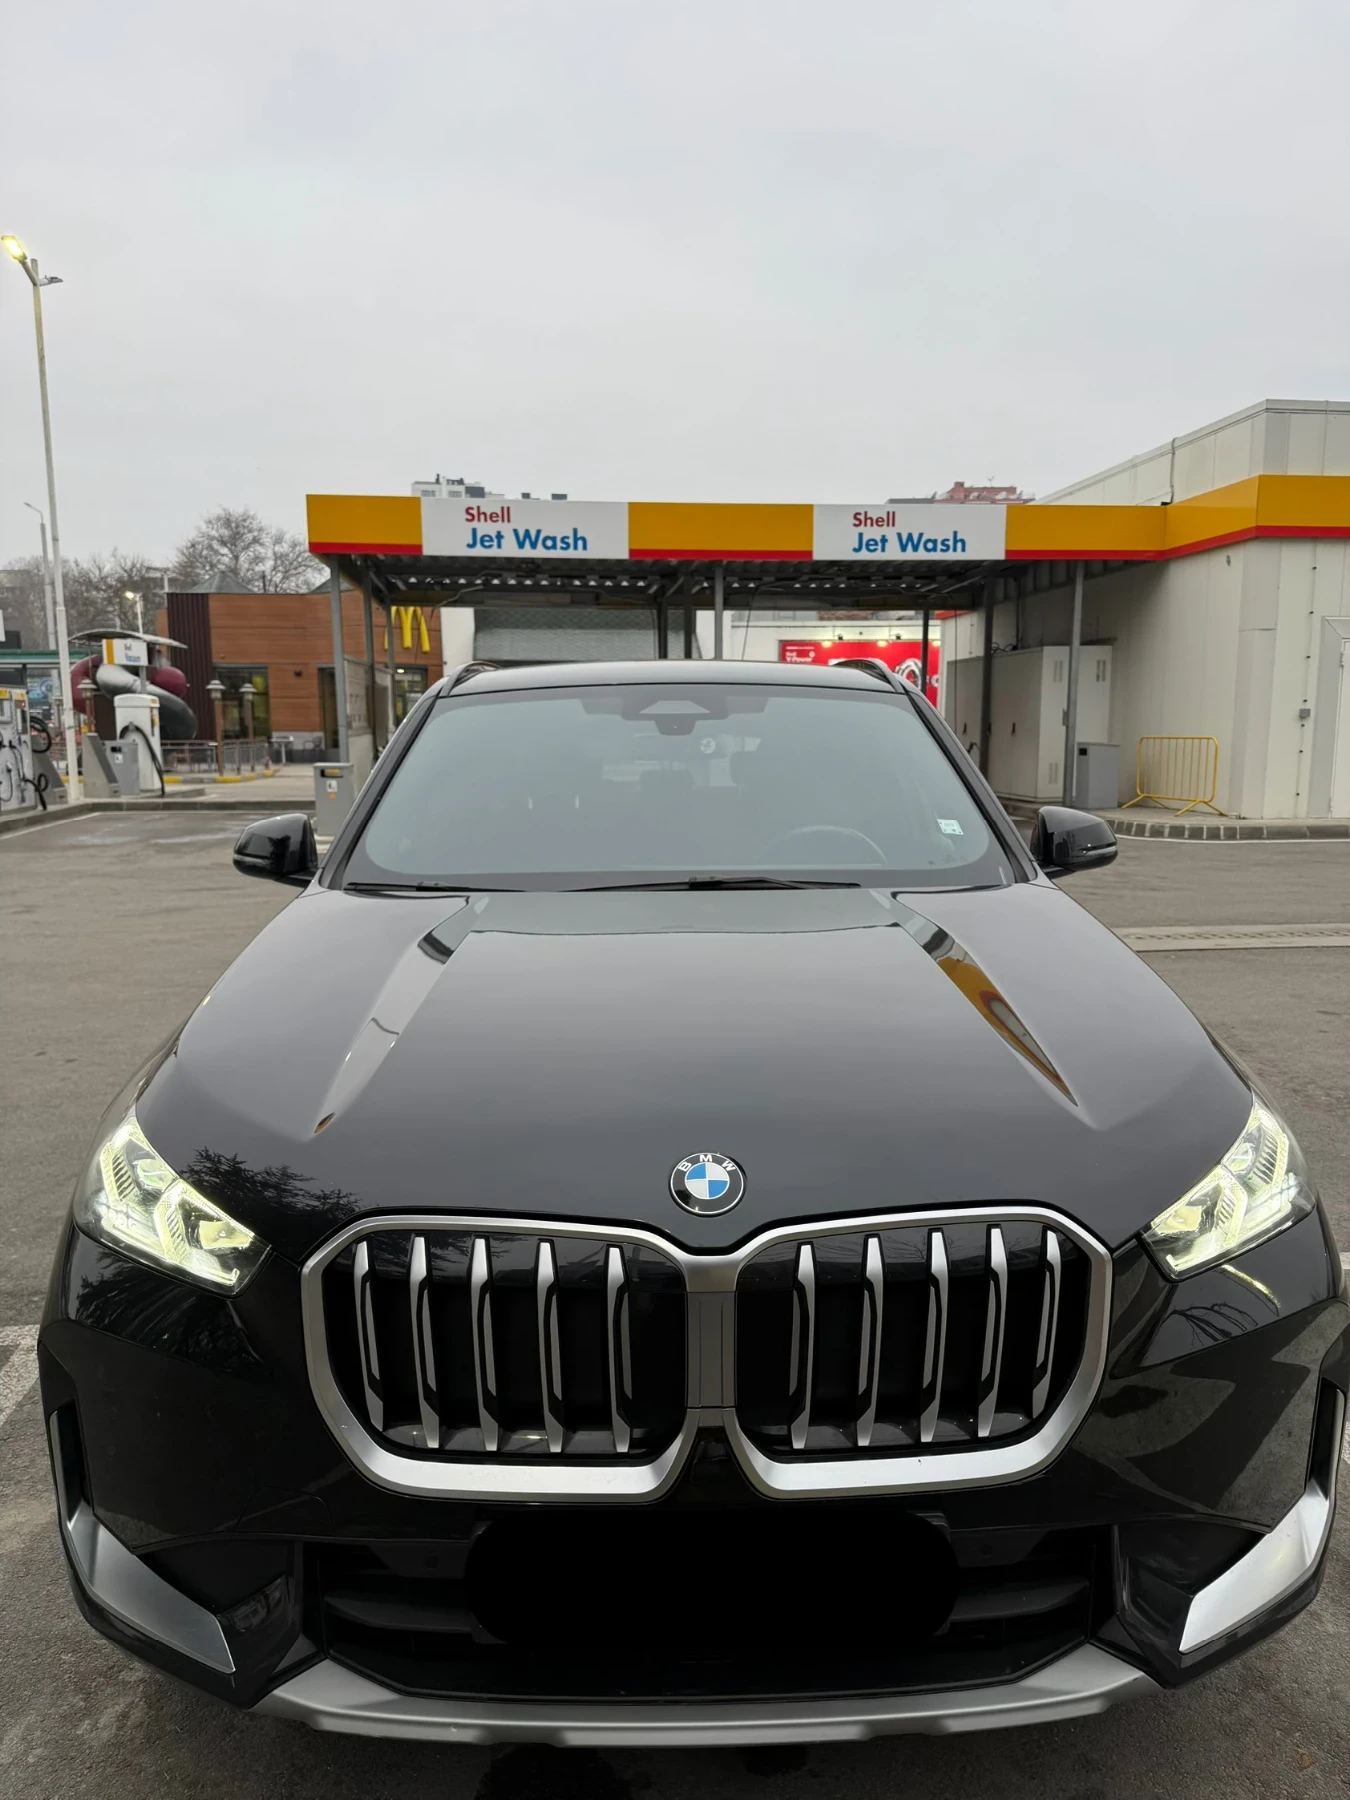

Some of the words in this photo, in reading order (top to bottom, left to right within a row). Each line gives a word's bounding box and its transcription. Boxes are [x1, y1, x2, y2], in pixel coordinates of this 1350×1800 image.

[465, 506, 511, 523] Shell
[853, 511, 896, 527] Shell
[466, 528, 504, 549] Jet
[513, 528, 588, 551] Wash
[852, 532, 888, 553] Jet
[897, 531, 967, 553] Wash
[677, 1154, 737, 1172] BMW
